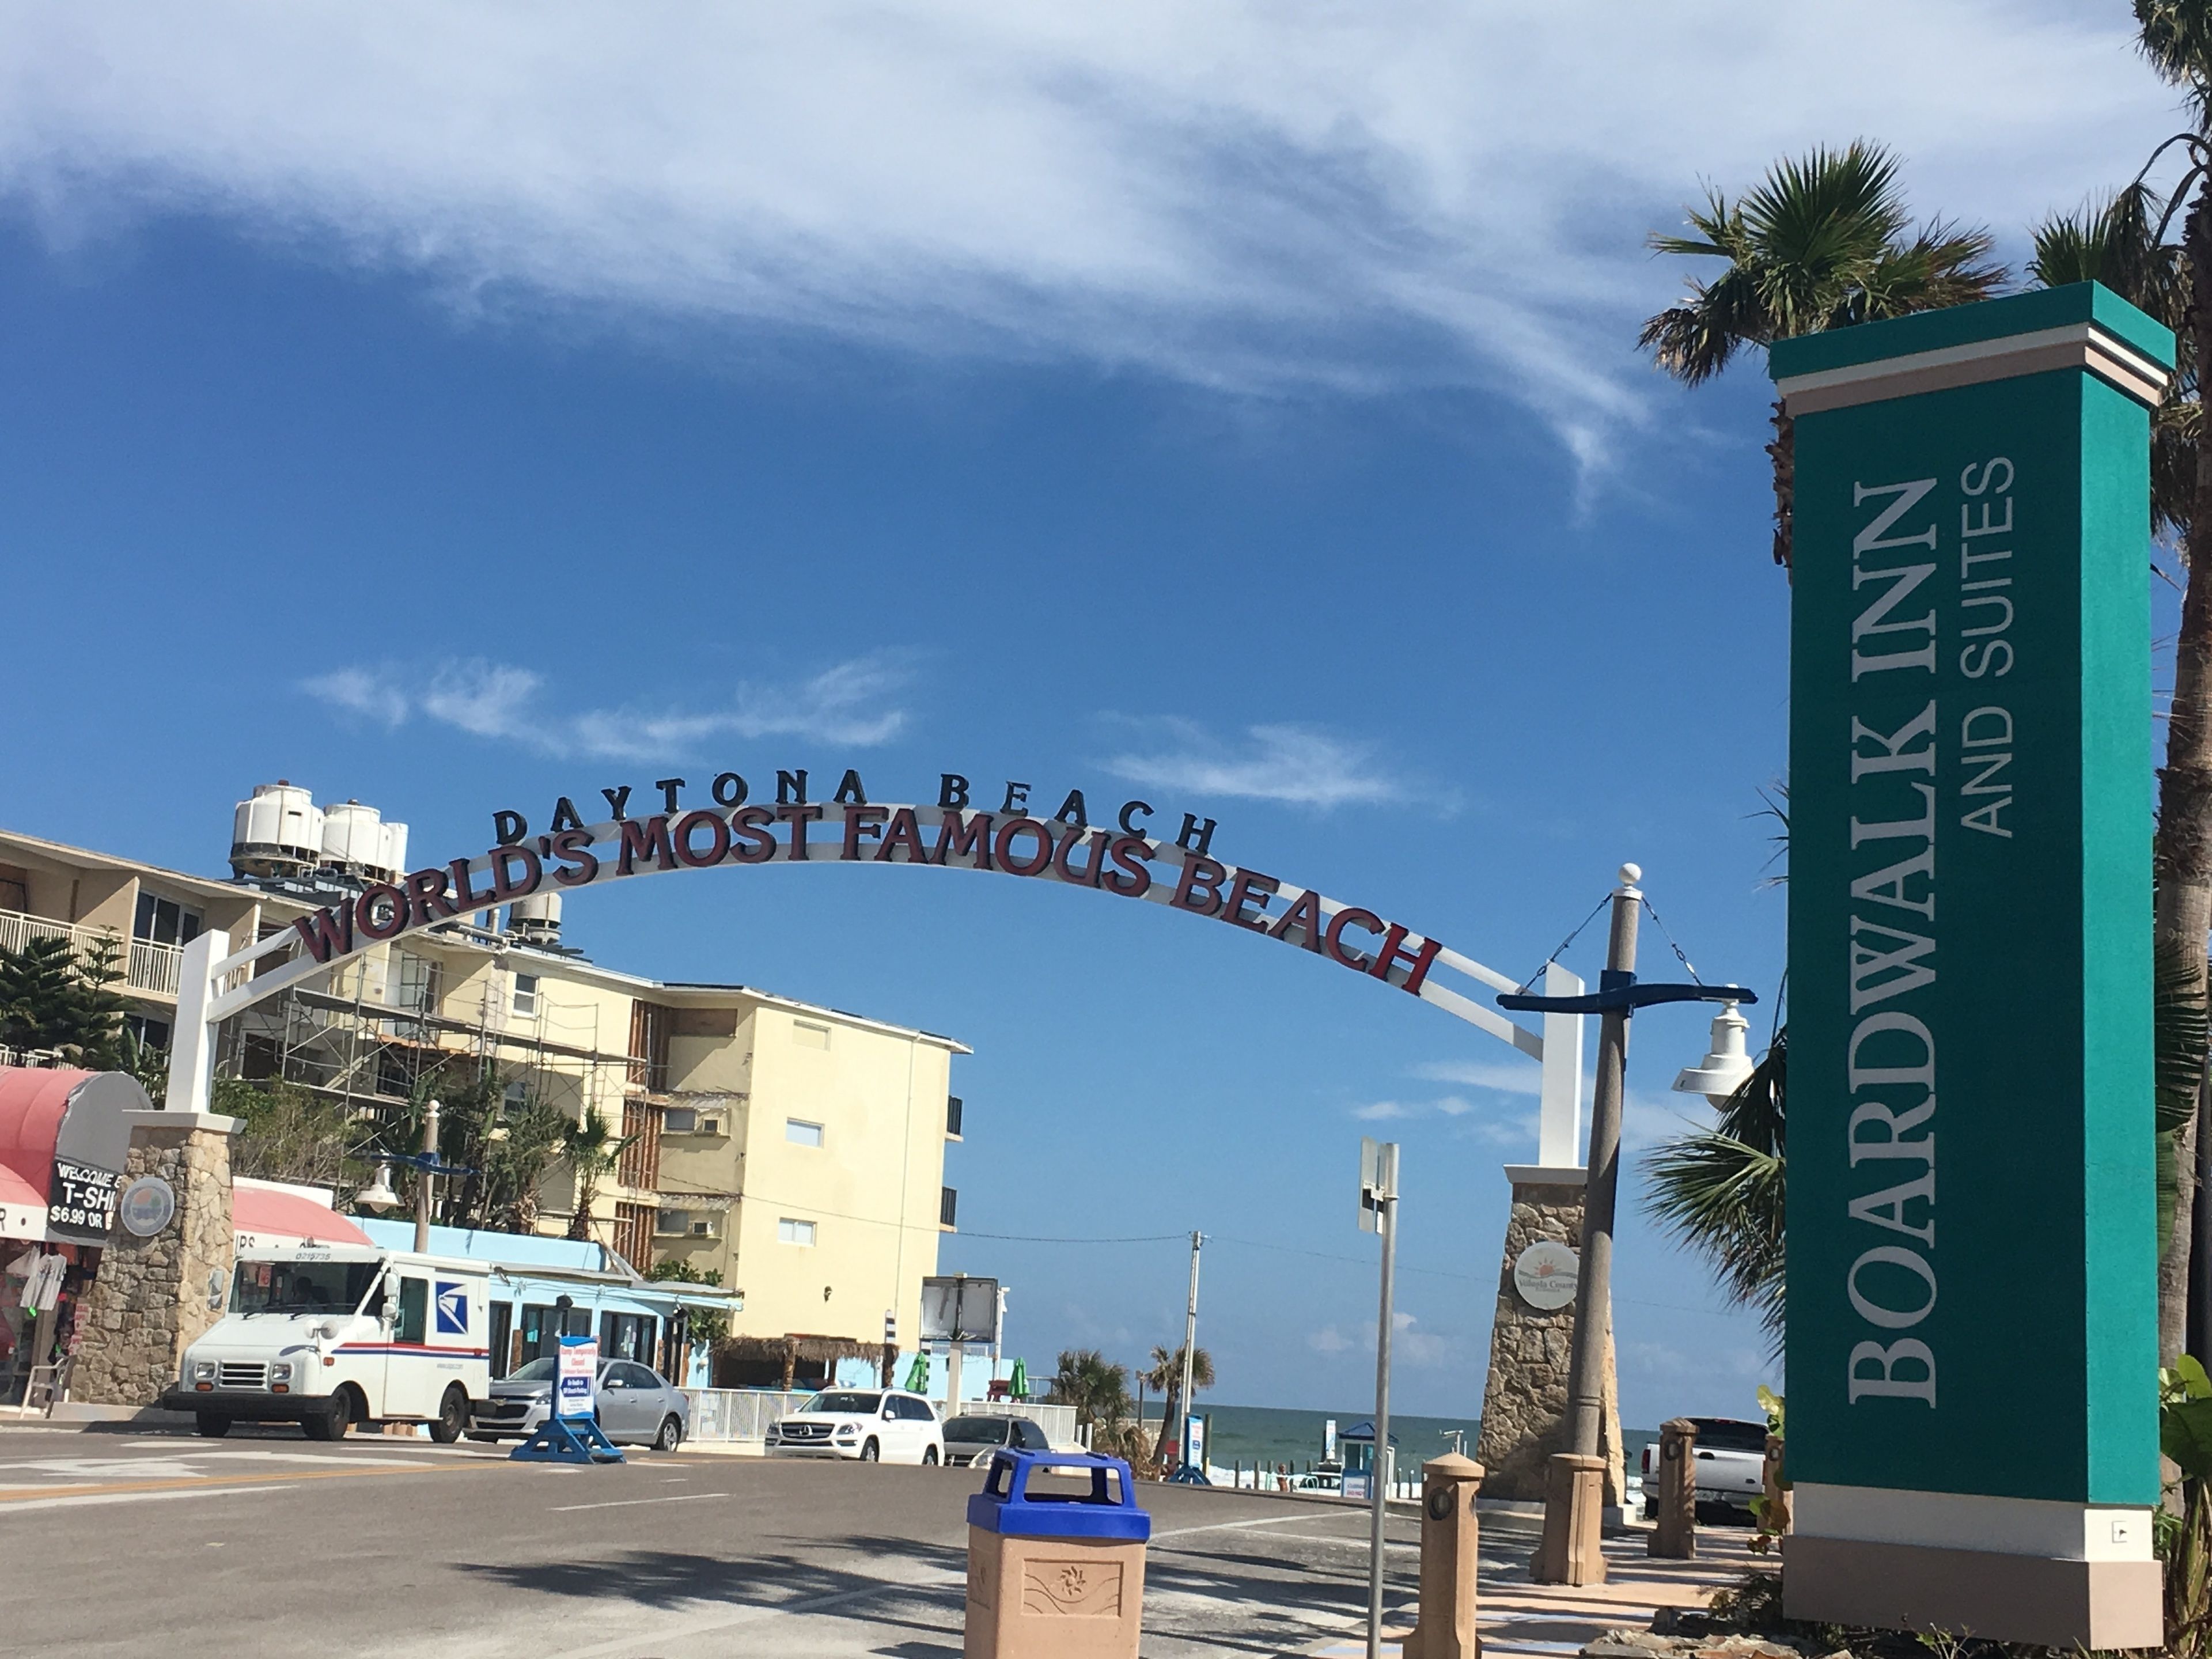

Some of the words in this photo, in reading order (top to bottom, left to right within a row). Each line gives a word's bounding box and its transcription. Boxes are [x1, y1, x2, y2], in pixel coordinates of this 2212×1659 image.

[1851, 477, 1937, 683] INN
[1960, 456, 2015, 679] SUITES
[492, 769, 868, 845] DAYTONA
[937, 773, 1218, 855] BEACH
[1960, 706, 2013, 838] AND
[291, 829, 599, 964] WORLD'S
[615, 806, 823, 876] MOST
[840, 806, 1156, 899] FAMOUS
[1169, 852, 1442, 997] BEACH
[1847, 699, 1937, 1409] BOARDWALK
[50, 1205, 85, 1226] $6.99
[88, 1211, 103, 1228] OR
[57, 1162, 114, 1188] WELCOME
[62, 1181, 116, 1211] T-SHI
